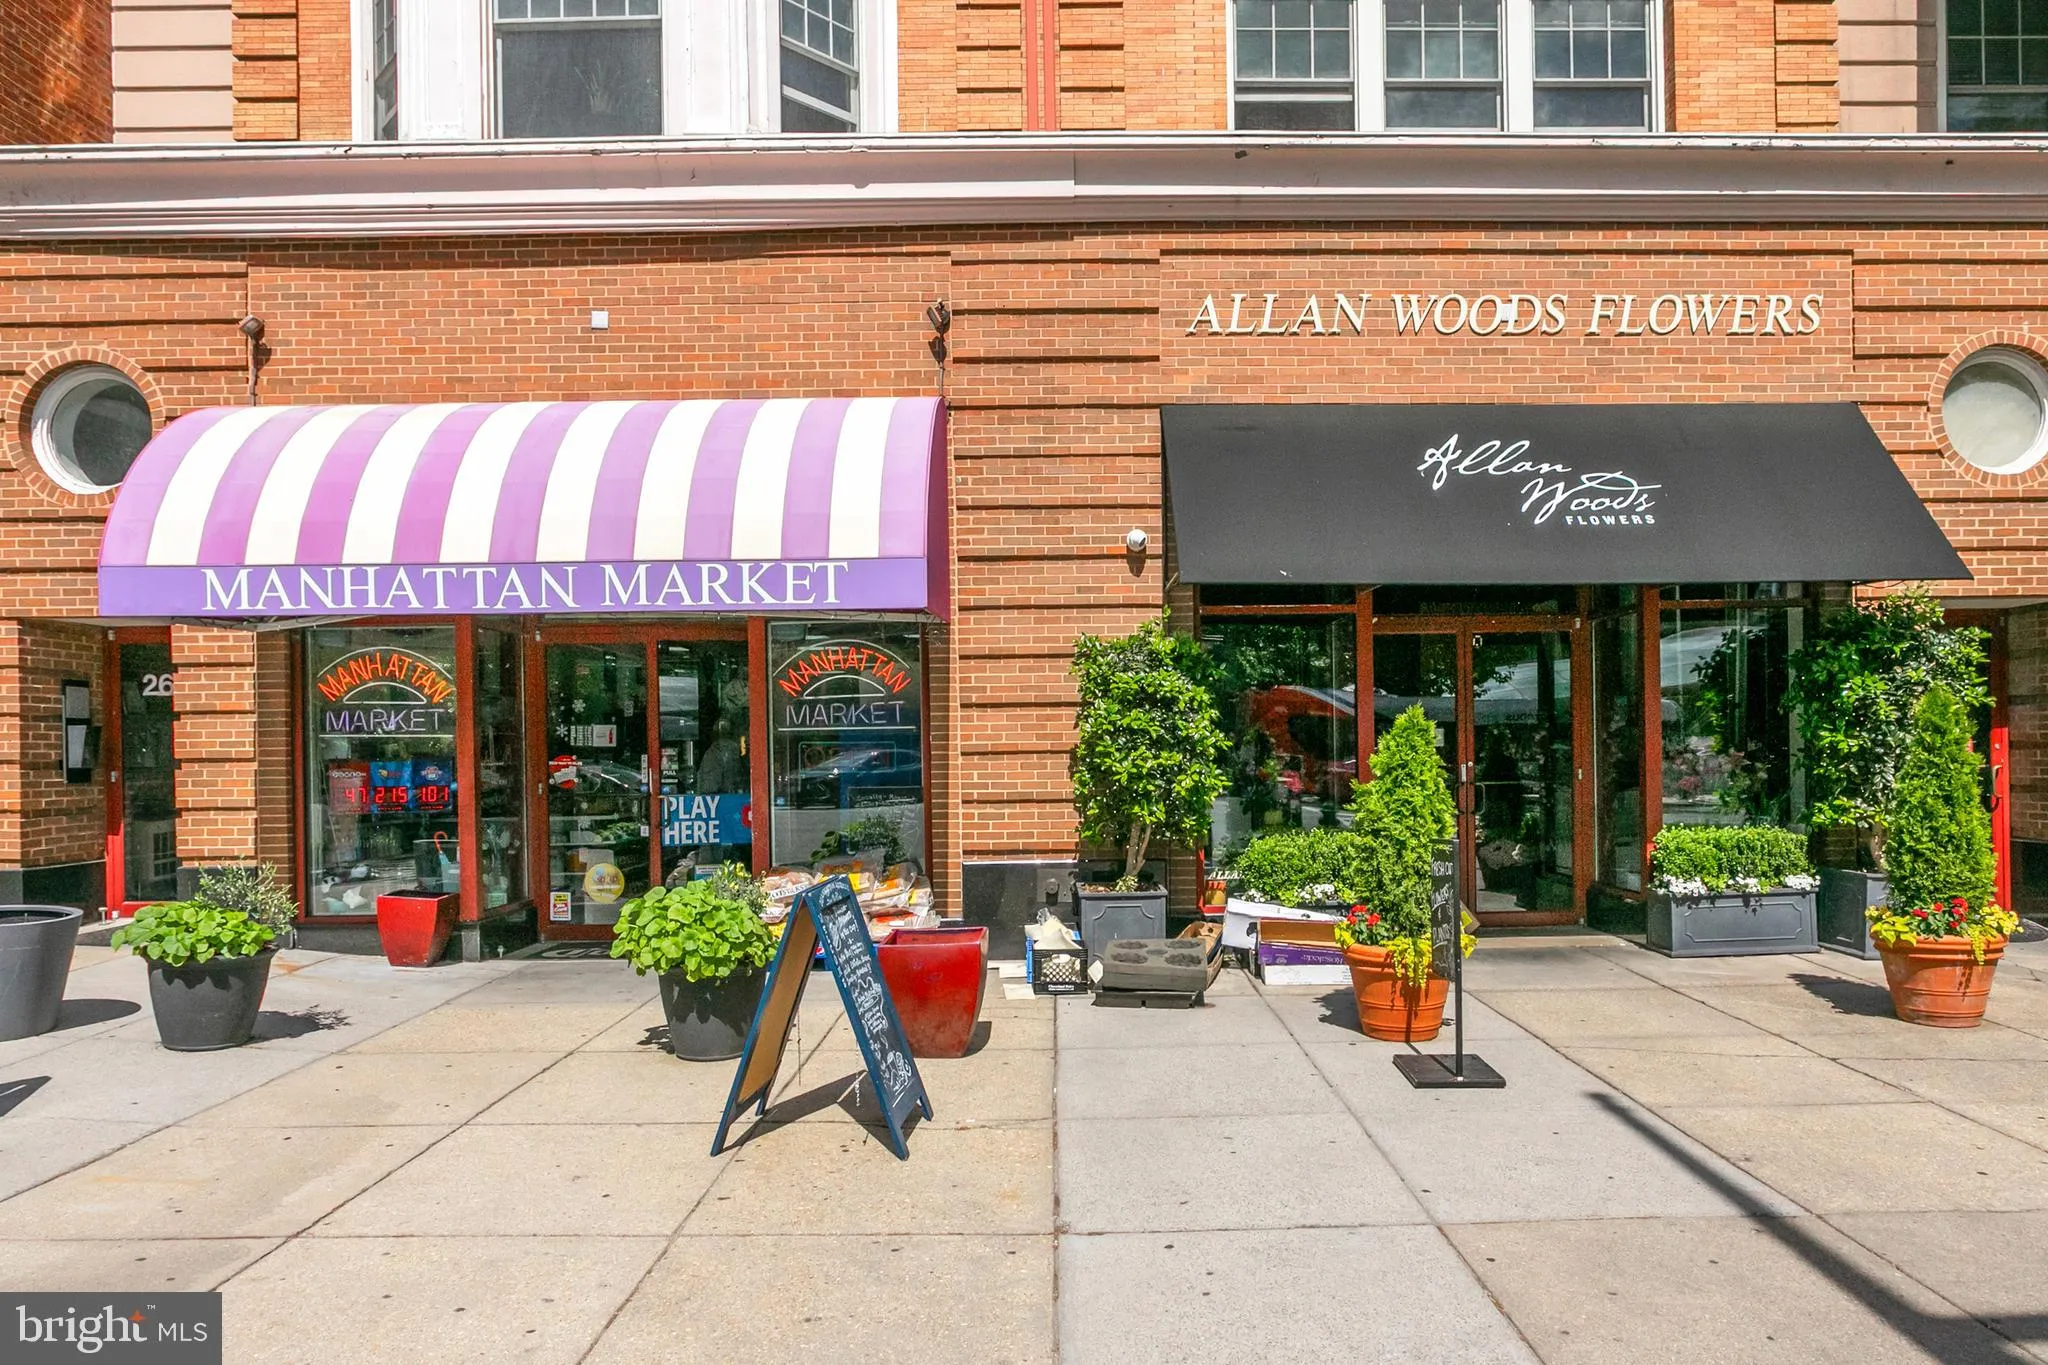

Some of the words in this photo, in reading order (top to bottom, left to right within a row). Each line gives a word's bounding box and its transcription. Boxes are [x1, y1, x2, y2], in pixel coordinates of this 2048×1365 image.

[1186, 293, 1372, 336] ALLAN
[1391, 293, 1567, 336] WOODS
[1585, 293, 1823, 336] FLOWERS
[1417, 433, 1572, 490] Allan
[1521, 471, 1662, 525] Woods
[1565, 514, 1656, 526] FLOWERS
[201, 566, 579, 611] MANHATTAN
[600, 561, 848, 606] MARKET
[317, 652, 454, 704] MANHATTAN
[779, 646, 912, 697] MANHATTAN
[325, 709, 445, 732] MARKET
[786, 701, 905, 726] MARKET
[664, 795, 720, 819] PLAY
[664, 820, 720, 845] HERE
